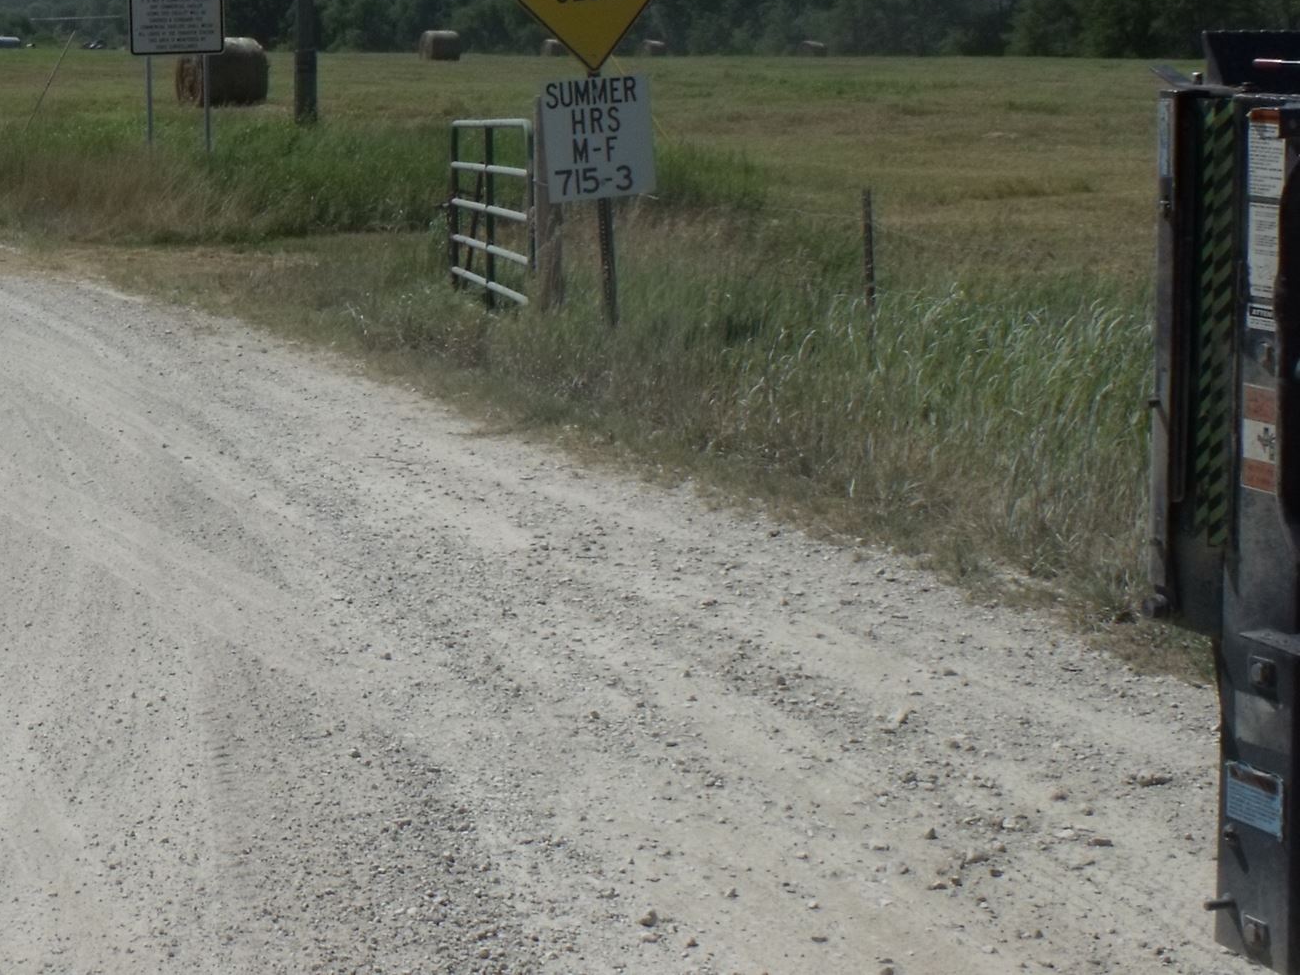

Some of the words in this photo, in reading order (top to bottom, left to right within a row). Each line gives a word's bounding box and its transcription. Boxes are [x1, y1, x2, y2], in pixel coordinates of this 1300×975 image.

[546, 76, 637, 109] SUMMER
[571, 106, 620, 135] HRS
[572, 136, 618, 164] M-F
